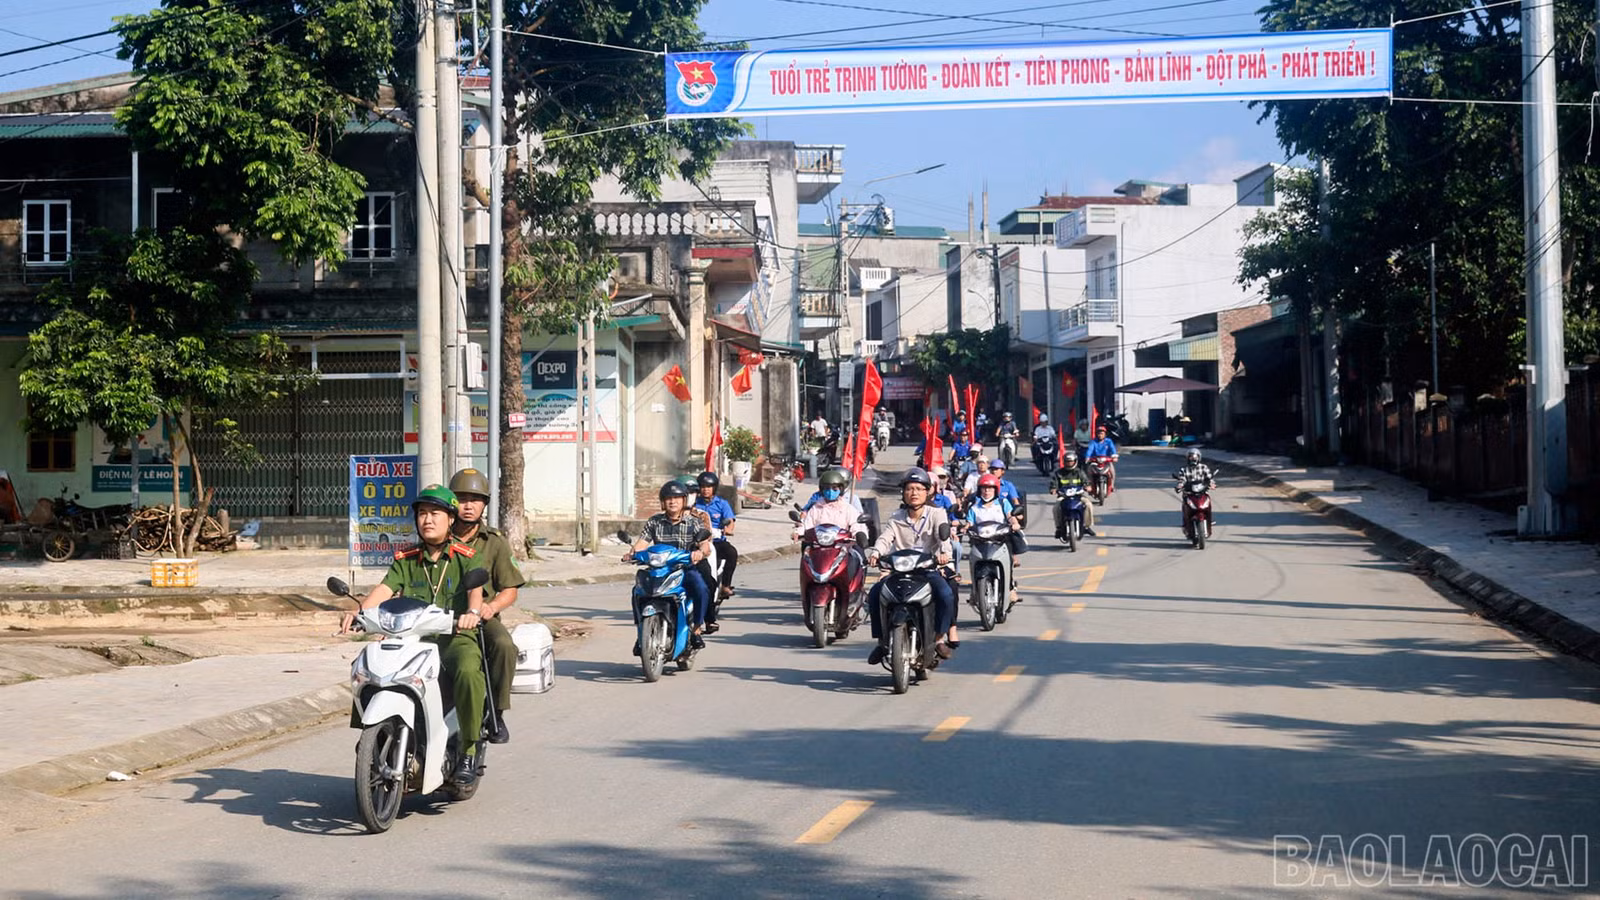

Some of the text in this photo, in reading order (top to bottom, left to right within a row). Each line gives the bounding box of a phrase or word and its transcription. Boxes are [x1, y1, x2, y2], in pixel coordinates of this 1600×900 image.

[770, 60, 801, 95] TUỔI
[805, 60, 830, 94] TRẺ
[835, 66, 876, 98] TRỊNH
[880, 58, 928, 90] TƯỜNG
[941, 56, 981, 89] ĐOÀN
[985, 54, 1011, 87] KẾT
[1025, 54, 1056, 86] TIÊN
[1061, 57, 1110, 85] PHONG
[1125, 48, 1154, 83] BẢN
[1159, 51, 1192, 82] LĨNH
[1207, 48, 1234, 86] ĐỘT
[1238, 48, 1267, 80] PHÁ
[1282, 47, 1320, 78] PHÁT
[1324, 39, 1366, 77] TRIỂN
[1370, 50, 1375, 76] !
[355, 458, 413, 477] RỬA XE
[99, 470, 120, 480] ĐIỆN
[144, 470, 155, 479] LÊ
[363, 482, 406, 498] Ô TÔ
[359, 504, 409, 517] XE MÁY
[377, 555, 394, 565] 640
